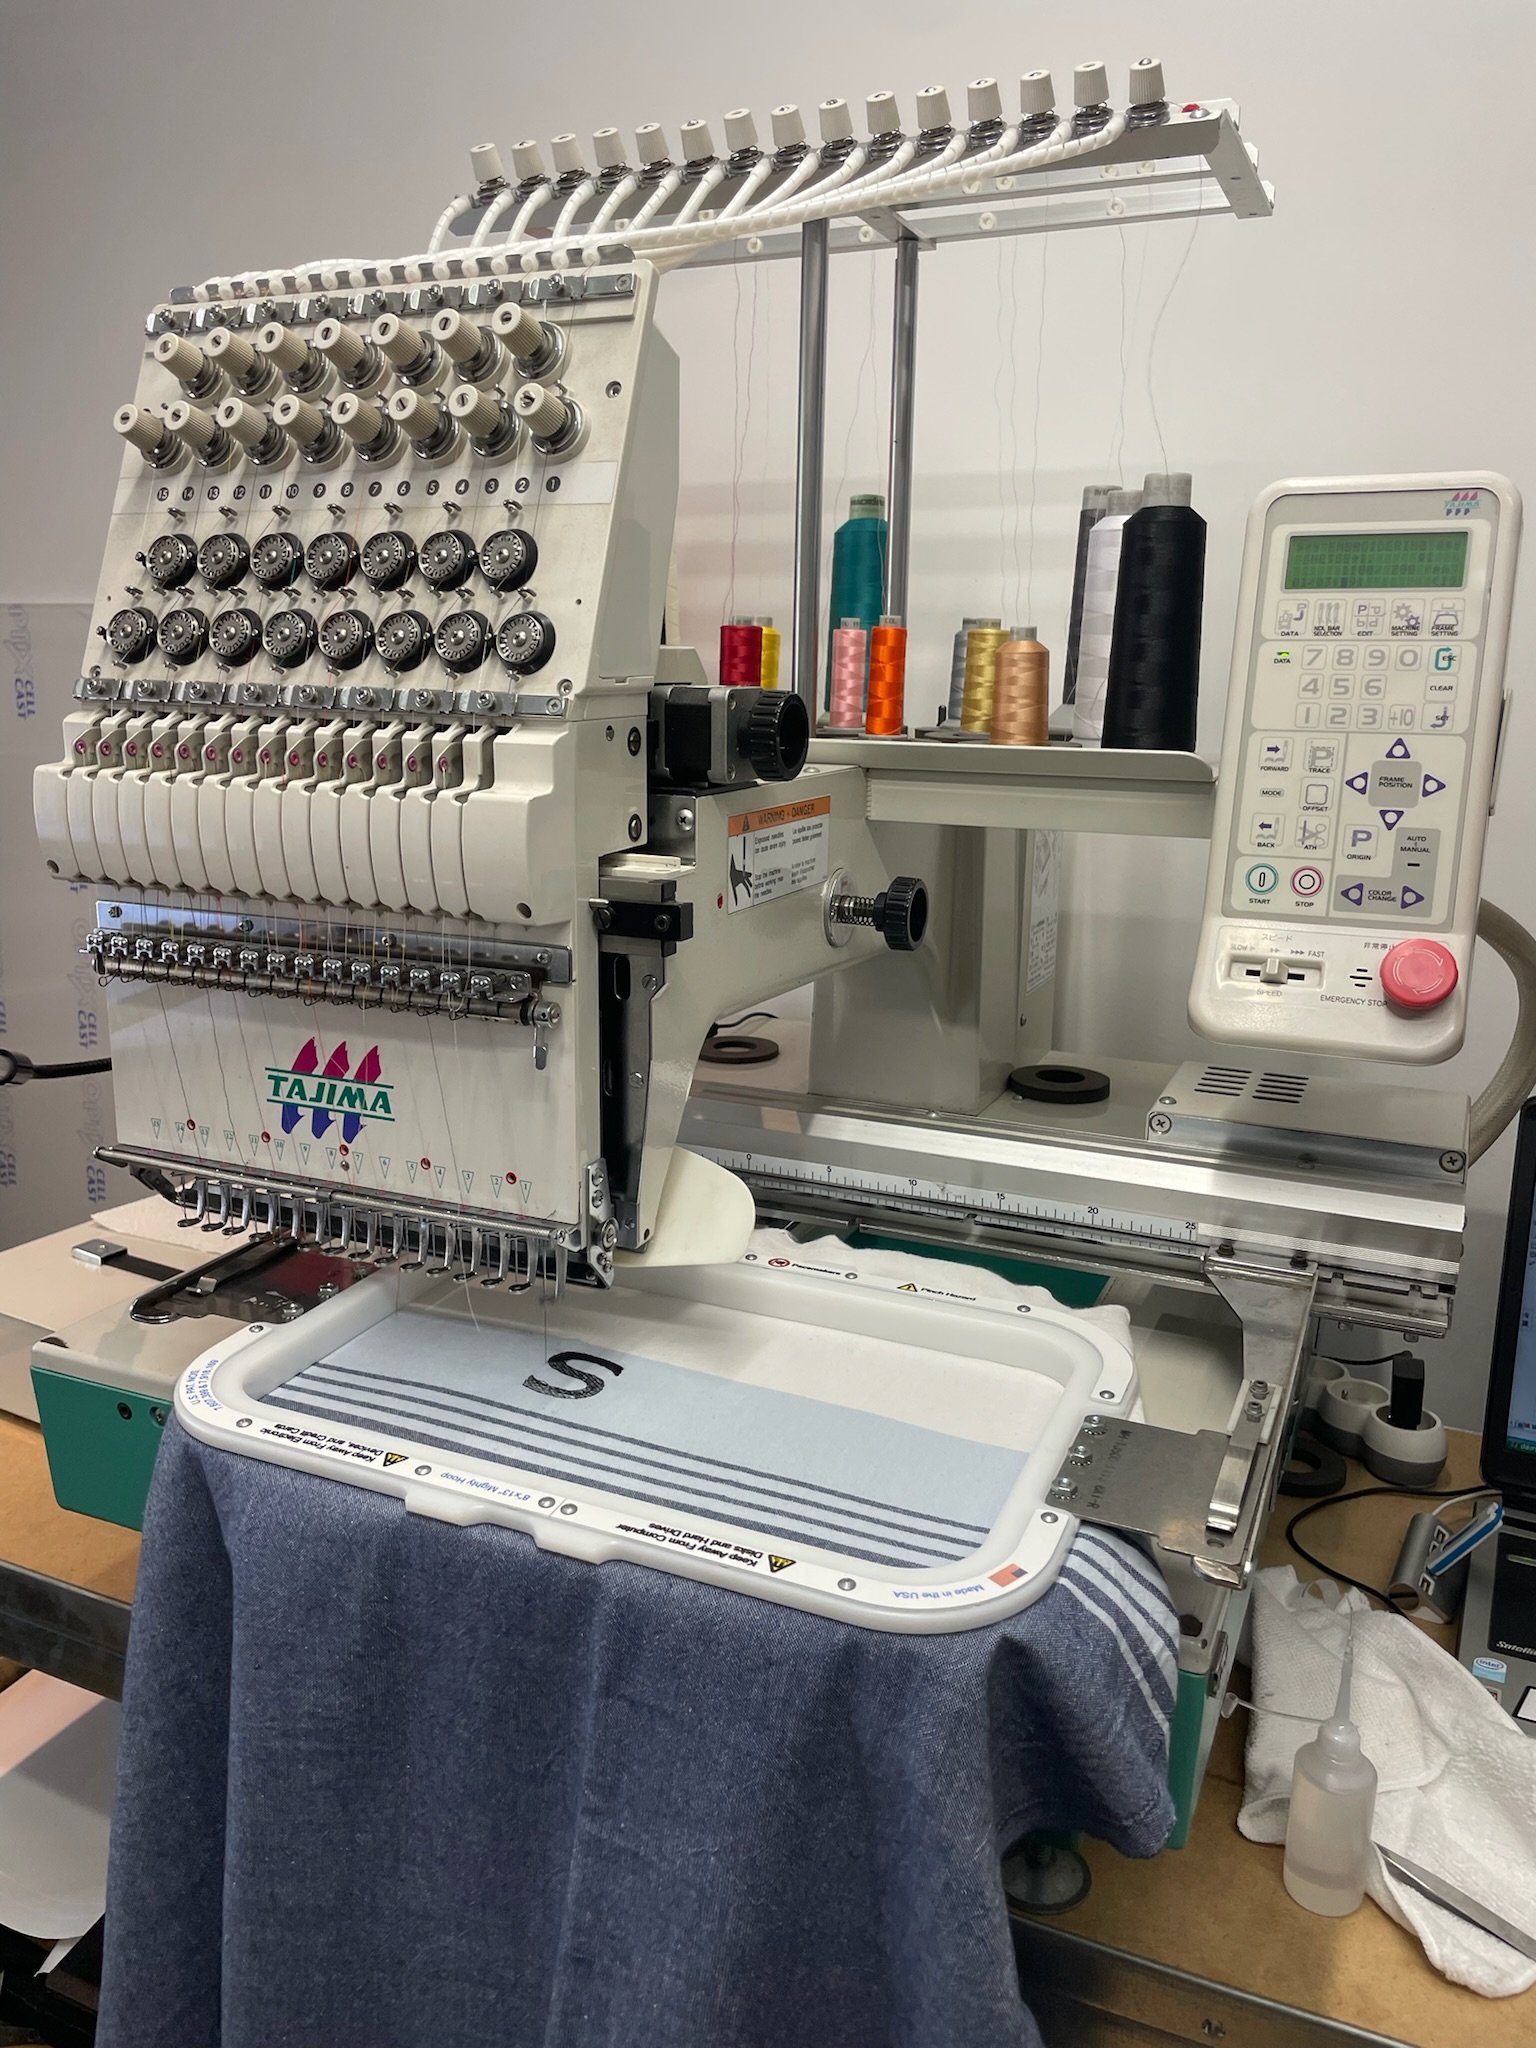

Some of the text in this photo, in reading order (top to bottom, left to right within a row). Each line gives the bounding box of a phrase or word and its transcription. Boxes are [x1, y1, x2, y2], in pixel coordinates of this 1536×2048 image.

[1306, 648, 1324, 666] 7
[1336, 648, 1354, 666] 8
[1368, 648, 1385, 667] 9
[1302, 678, 1382, 696] 4 5 6
[15, 678, 26, 720] CAST
[1304, 707, 1311, 724] 1
[1329, 707, 1347, 725] 2
[1361, 708, 1378, 725] 3
[1367, 894, 1396, 902] CHANGE
[1368, 889, 1392, 897] COLOR
[1262, 933, 1293, 942] スピード
[1308, 950, 1325, 958] FAST
[1320, 994, 1388, 1008] EMERGENCY STOP
[77, 1010, 89, 1049] CAST
[87, 1012, 98, 1046] CELL
[267, 1074, 392, 1114] TAJIMA
[86, 1165, 97, 1203] CAST
[96, 1168, 106, 1201] CELL
[908, 1179, 917, 1187] 10
[996, 1193, 1005, 1201] 15
[1087, 1206, 1099, 1214] 20
[1185, 1222, 1196, 1230] 25
[920, 1287, 944, 1296] Pinch
[522, 1350, 625, 1400] S
[260, 1428, 376, 1463] Keep Away From Electronic
[274, 1423, 384, 1456] Devices, and Credit Cards
[440, 1472, 467, 1484] Hoop
[467, 1479, 499, 1493] Mighty
[615, 1523, 758, 1567] Keep Away From Computer
[648, 1523, 764, 1559] Disks and Hard Drives
[893, 1591, 919, 1599] USA
[921, 1591, 940, 1599] the
[954, 1584, 985, 1595] Made
[1480, 1659, 1500, 1669] intel
